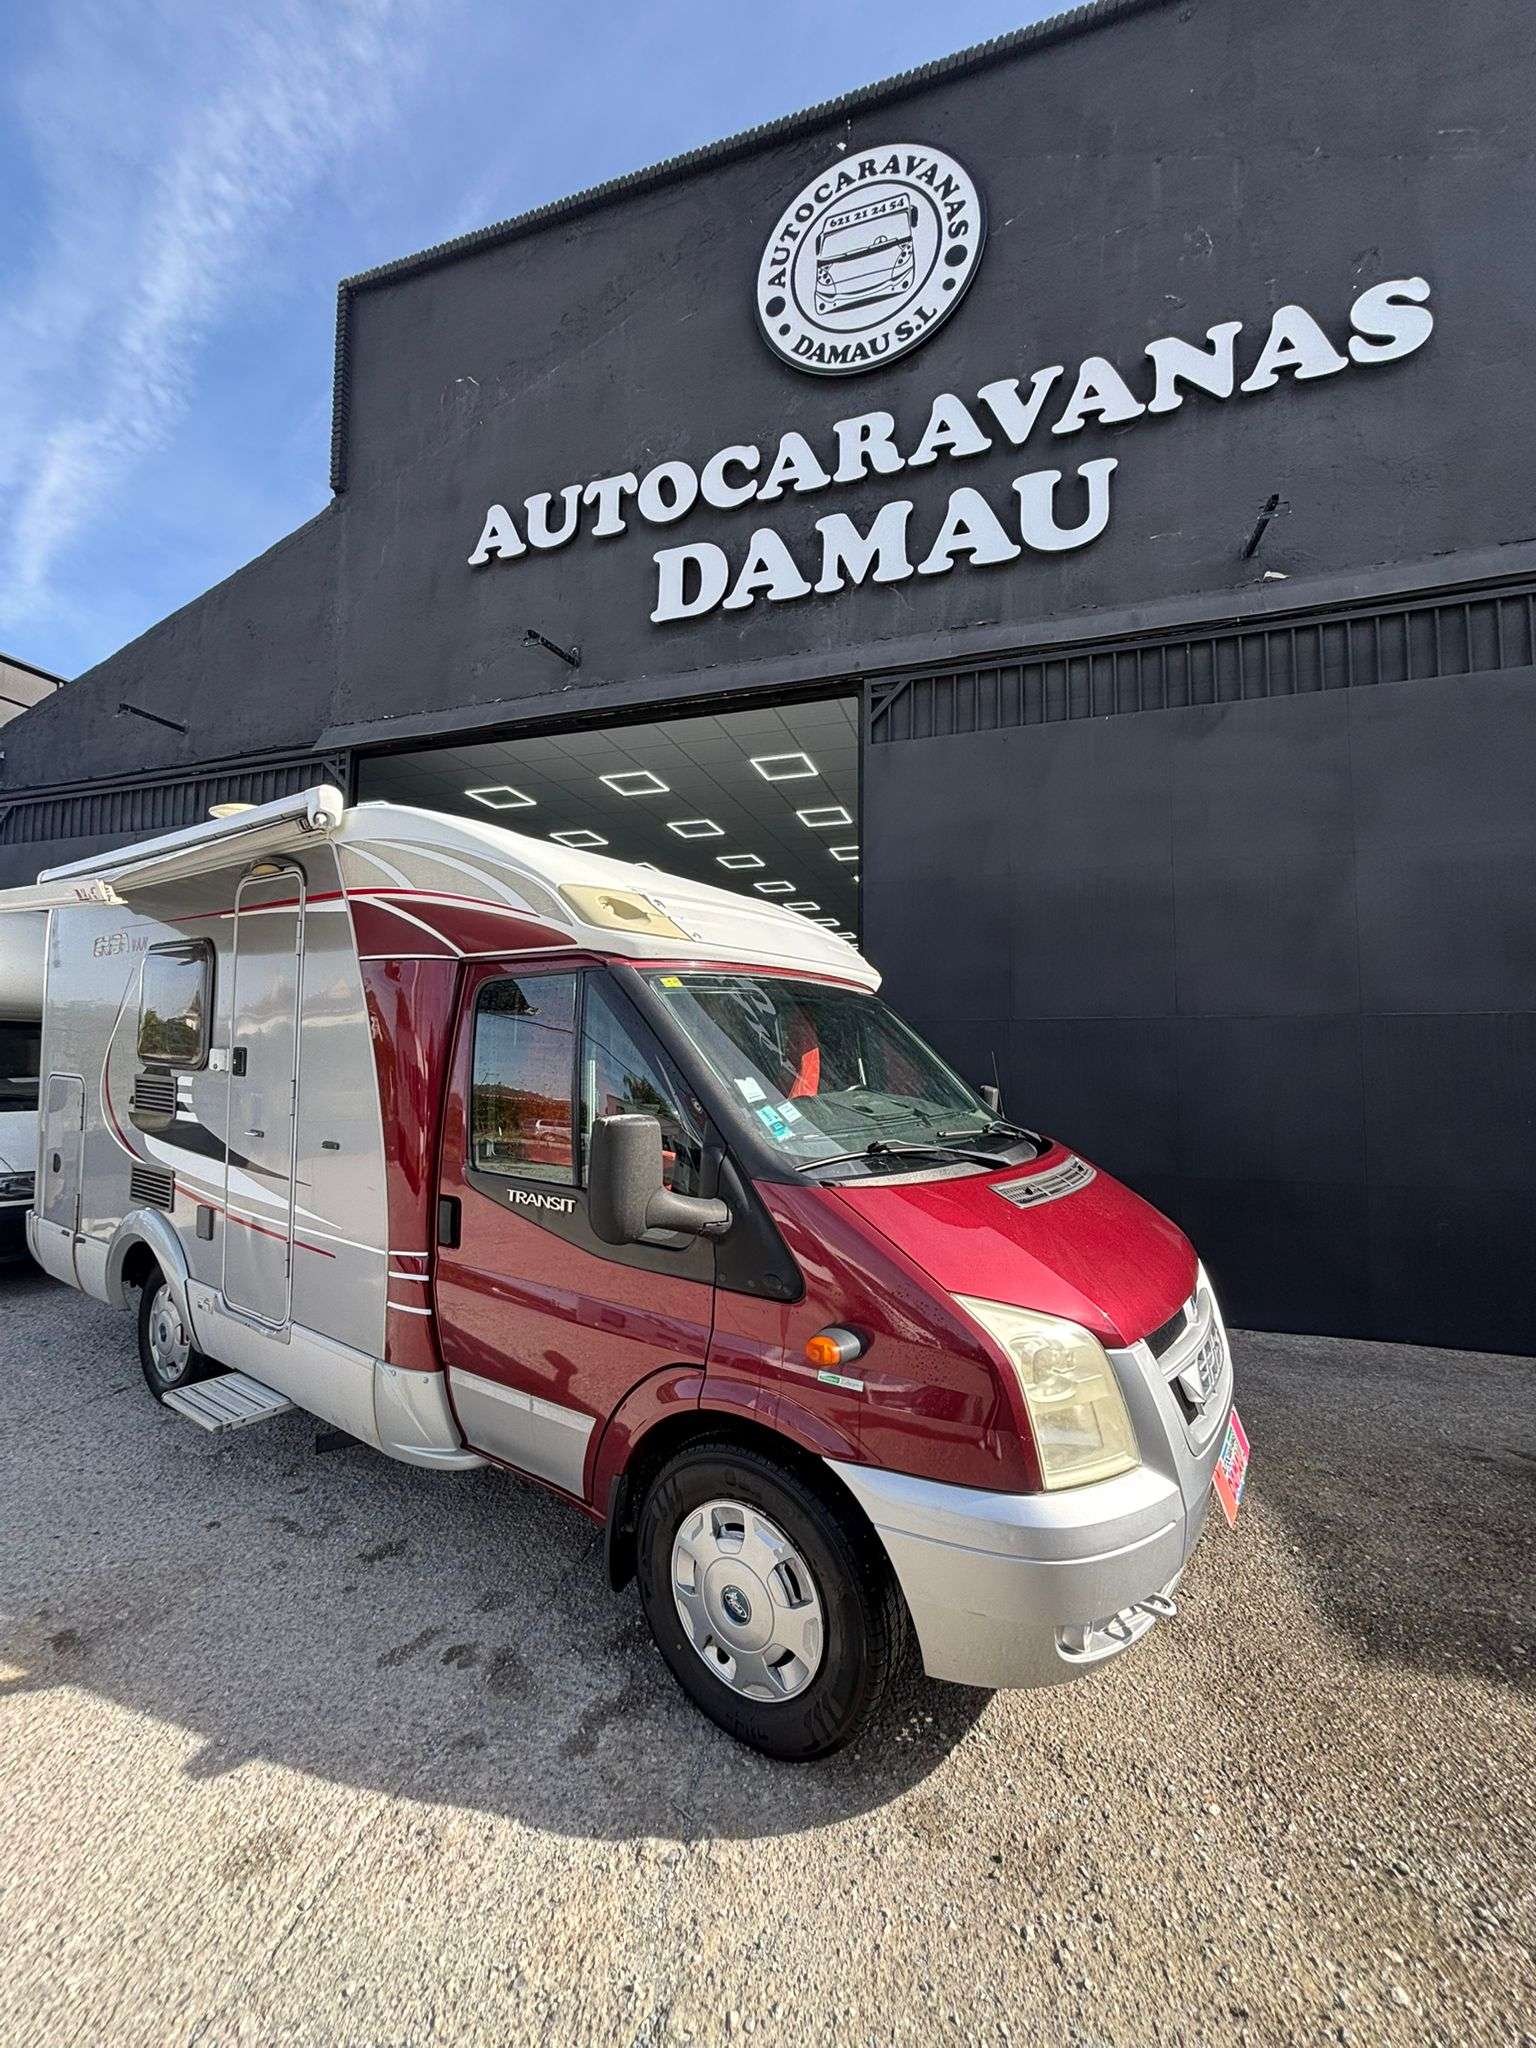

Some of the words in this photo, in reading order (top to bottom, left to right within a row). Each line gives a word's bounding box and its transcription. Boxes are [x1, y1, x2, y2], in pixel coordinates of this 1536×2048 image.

[767, 154, 969, 289] AUTOCARAVANAS
[829, 215, 851, 228] 621
[854, 209, 868, 221] 21
[871, 203, 887, 215] 24
[889, 198, 904, 211] 54
[791, 333, 891, 365] DAMAU
[895, 305, 938, 343] S.L
[466, 276, 1435, 567] AUTOCARAVANAS
[649, 457, 1119, 624] DAMAU
[506, 1188, 577, 1213] TRANSIT
